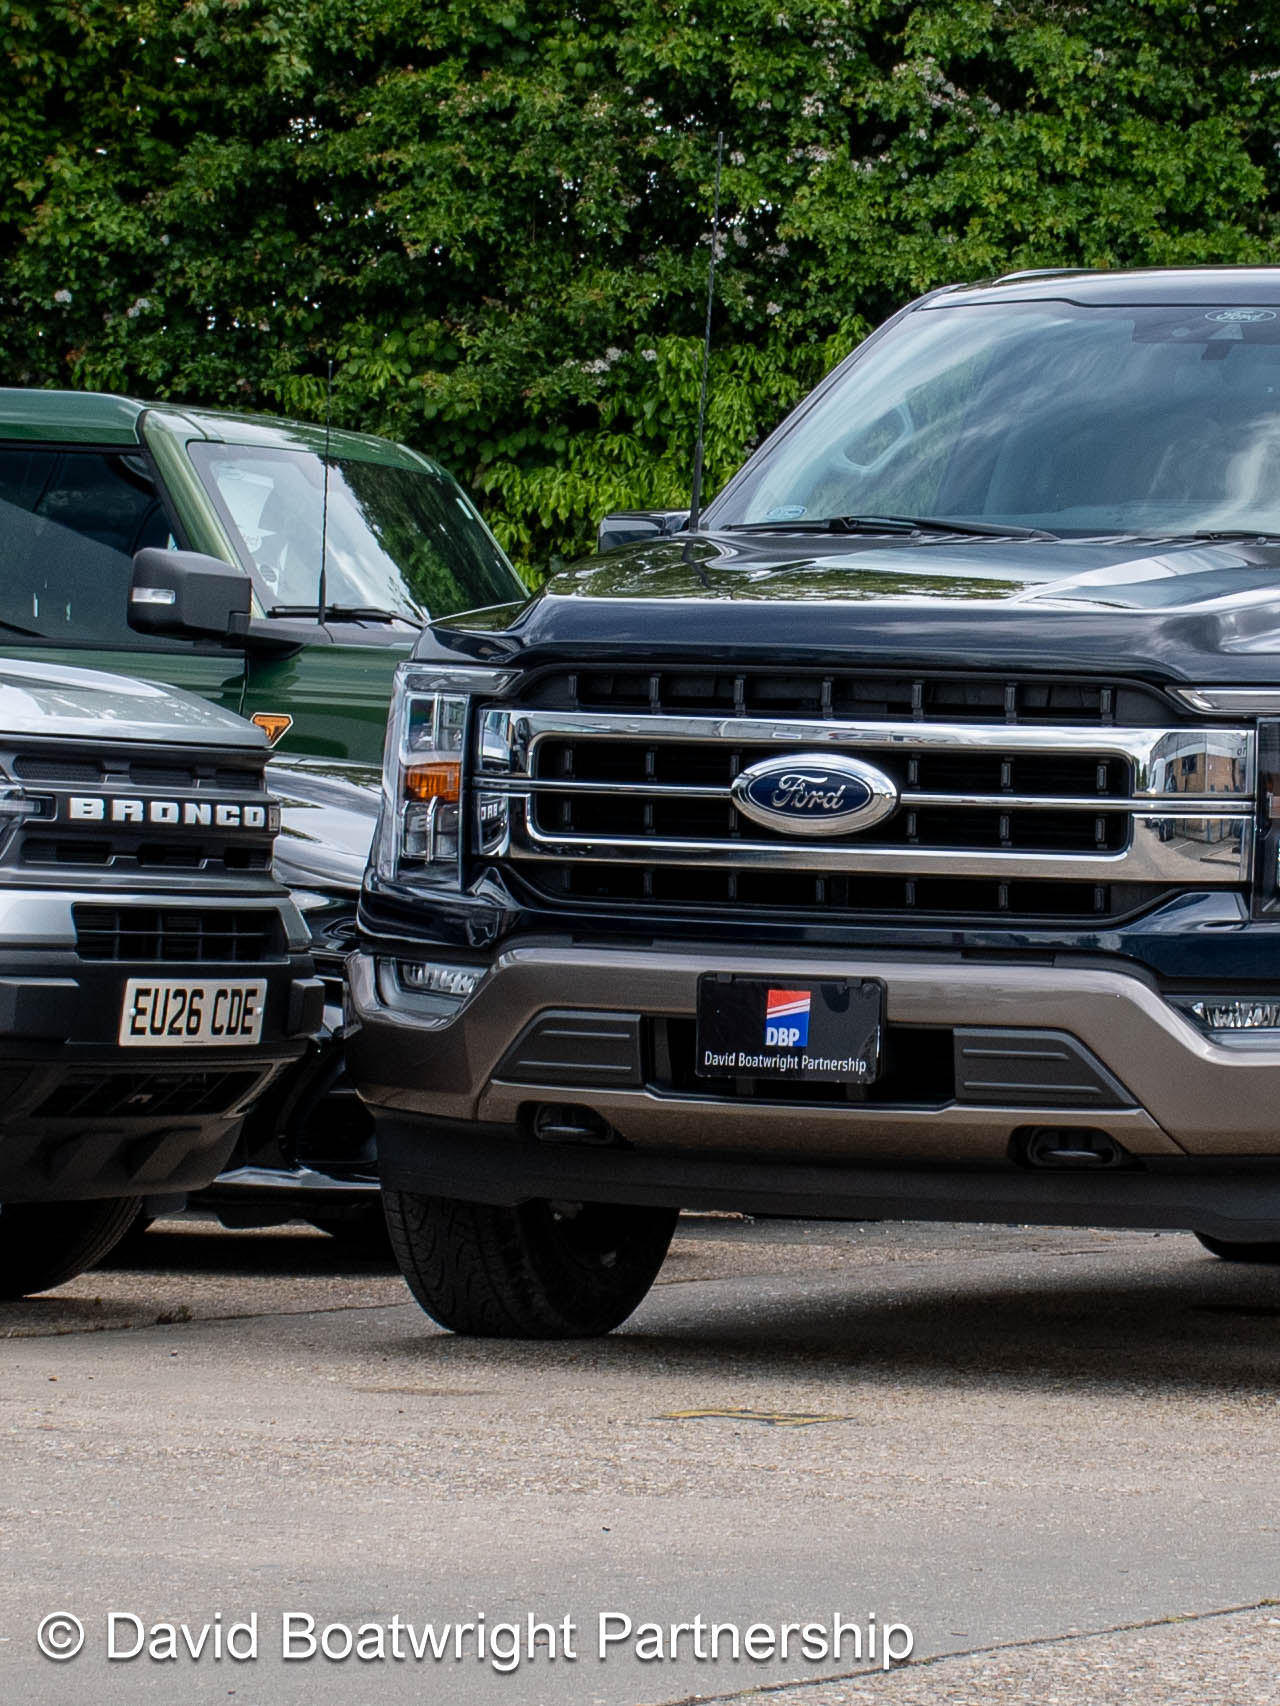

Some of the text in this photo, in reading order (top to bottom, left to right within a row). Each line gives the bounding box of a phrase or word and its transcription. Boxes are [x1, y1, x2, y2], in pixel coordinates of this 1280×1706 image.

[770, 774, 847, 809] Ford
[69, 797, 266, 827] BRONCO
[130, 988, 257, 1036] EU26 CDE
[765, 1026, 801, 1047] DBP
[704, 1051, 867, 1075] David Boatwright Partnership
